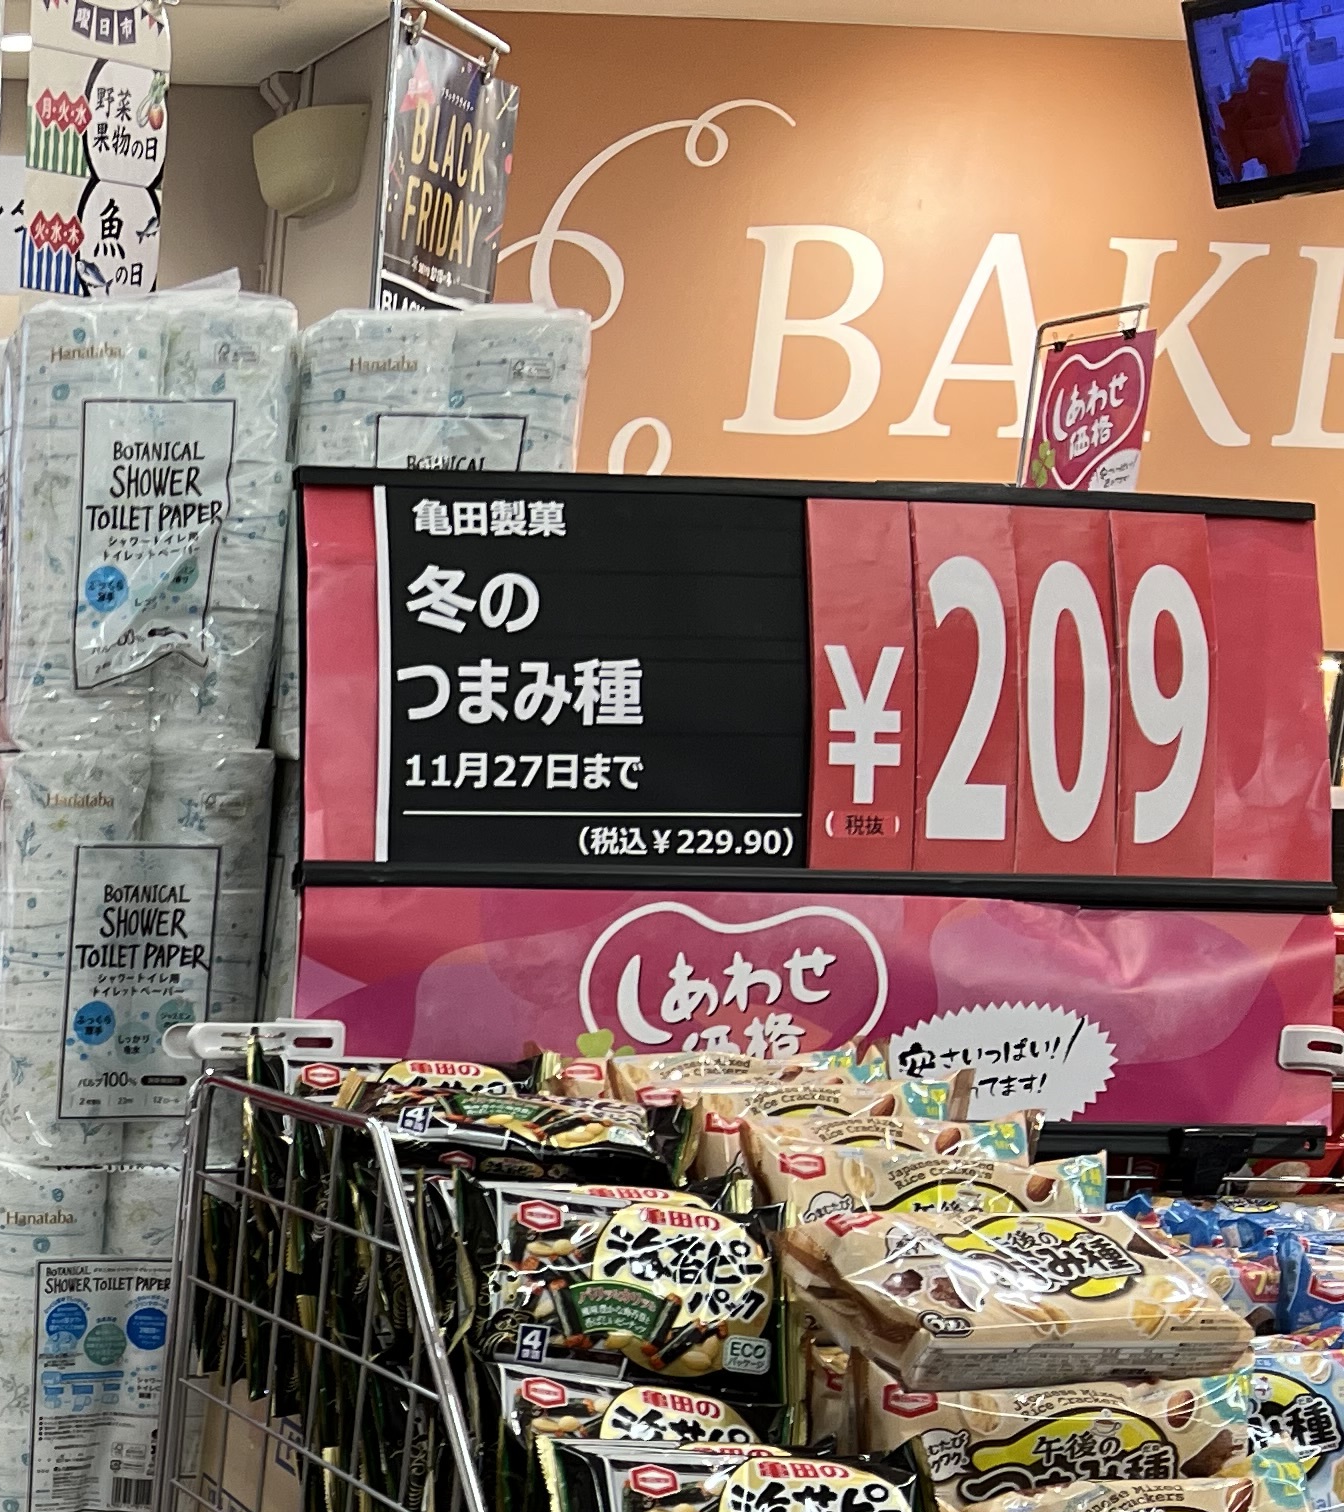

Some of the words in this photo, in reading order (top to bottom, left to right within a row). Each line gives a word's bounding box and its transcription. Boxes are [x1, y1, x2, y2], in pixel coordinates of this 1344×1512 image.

[95, 86, 134, 122] 野菜
[92, 122, 160, 163] 果物の日
[410, 97, 491, 196] BLACK
[93, 198, 127, 260] 魚
[401, 174, 484, 269] FRIDAY
[115, 262, 145, 288] の日
[1052, 371, 1130, 443] しあわせ
[112, 440, 207, 462] BOTANICAL
[1068, 414, 1115, 461] 価格
[108, 463, 204, 499] SHOWER
[85, 503, 154, 533] TOILET
[158, 499, 225, 532] PAPER
[411, 498, 568, 538] 亀田製菓
[405, 564, 542, 635] 冬の
[396, 658, 645, 728] つまみ種
[404, 751, 645, 792] 11月27日まで
[103, 883, 192, 904] BOTANICAL
[98, 905, 189, 940] SHOWER
[74, 943, 141, 971] TOILET
[142, 942, 212, 972] PAPER
[619, 945, 837, 1047] しあわせ
[893, 1172, 925, 1190] Rice
[4, 1209, 75, 1226] Hanataba
[44, 1275, 91, 1295] SHOWER
[92, 1275, 133, 1292] TOILET
[134, 1274, 172, 1291] PAPER
[45, 1265, 92, 1278] BOTANICAL
[686, 1288, 767, 1323] パック
[729, 1341, 767, 1360] ECO
[642, 1390, 724, 1420] 亀田の
[1034, 1434, 1121, 1466] 午後の
[758, 1461, 851, 1480] 亀田の
